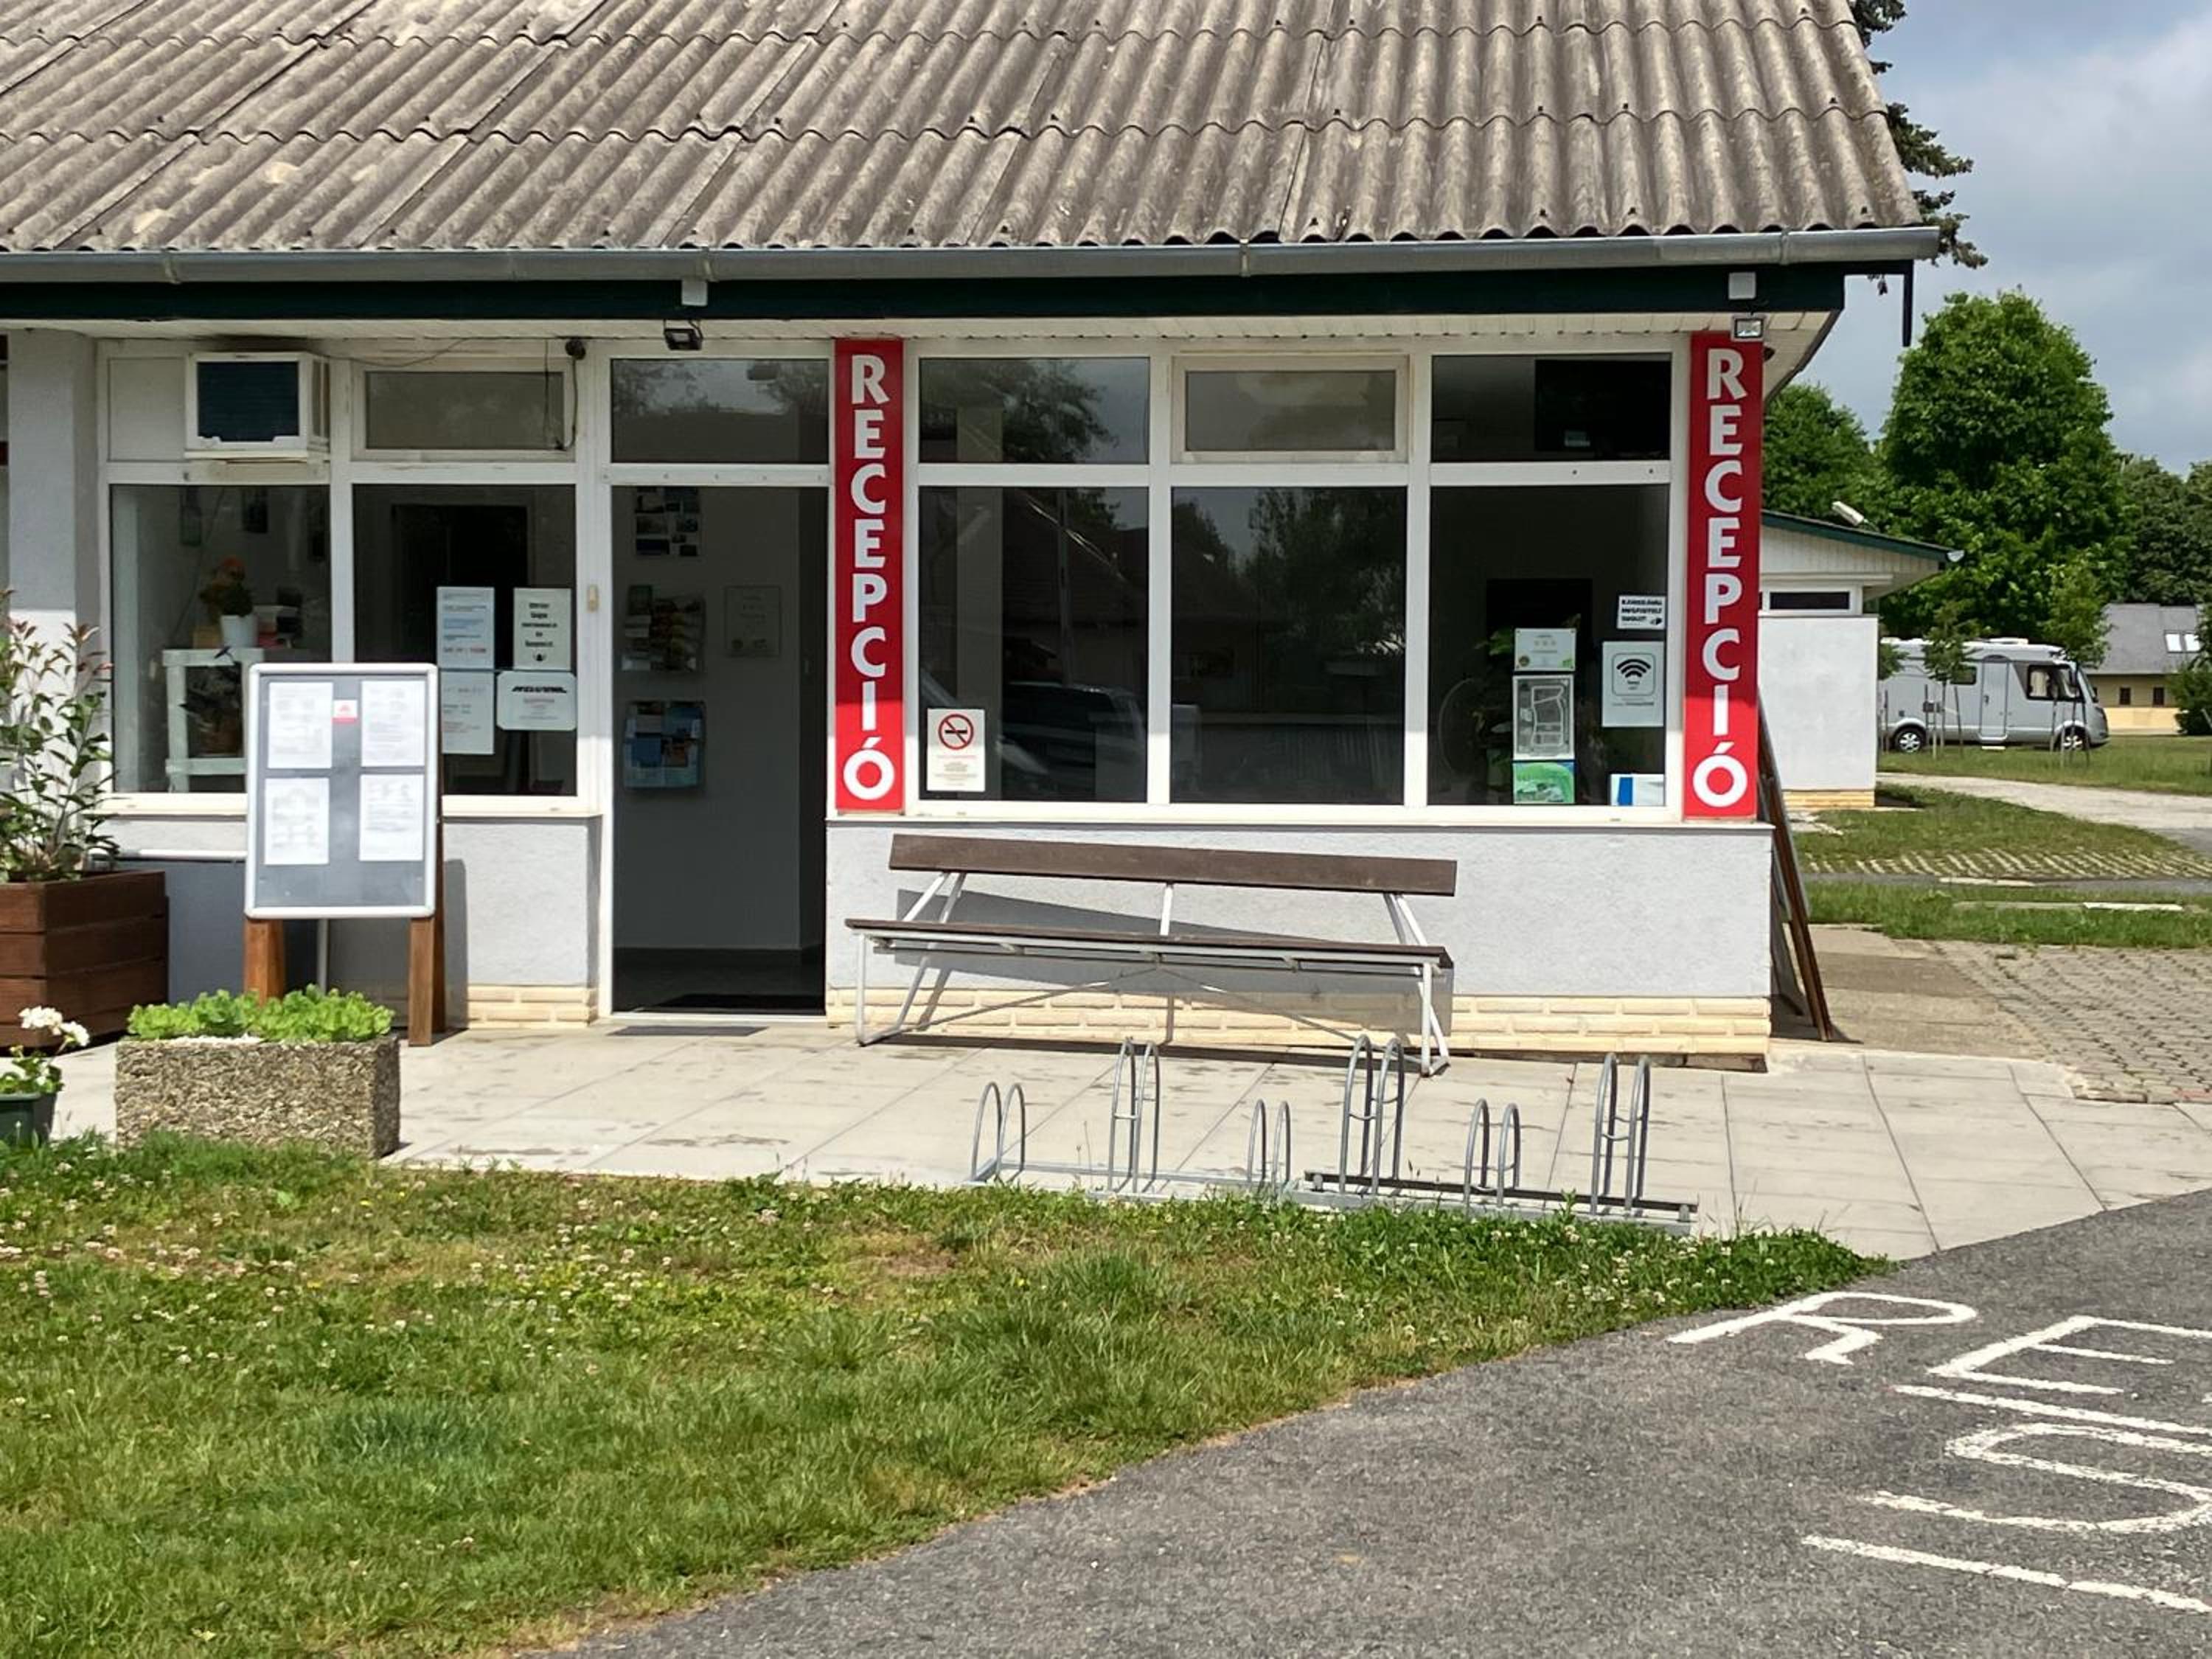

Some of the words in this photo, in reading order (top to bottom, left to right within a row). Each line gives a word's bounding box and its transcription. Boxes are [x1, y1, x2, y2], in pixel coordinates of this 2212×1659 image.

[843, 354, 895, 801] RECEPCIÓ
[1692, 348, 1747, 807] RECEPCIÓ
[1666, 1290, 2212, 1404] RE
